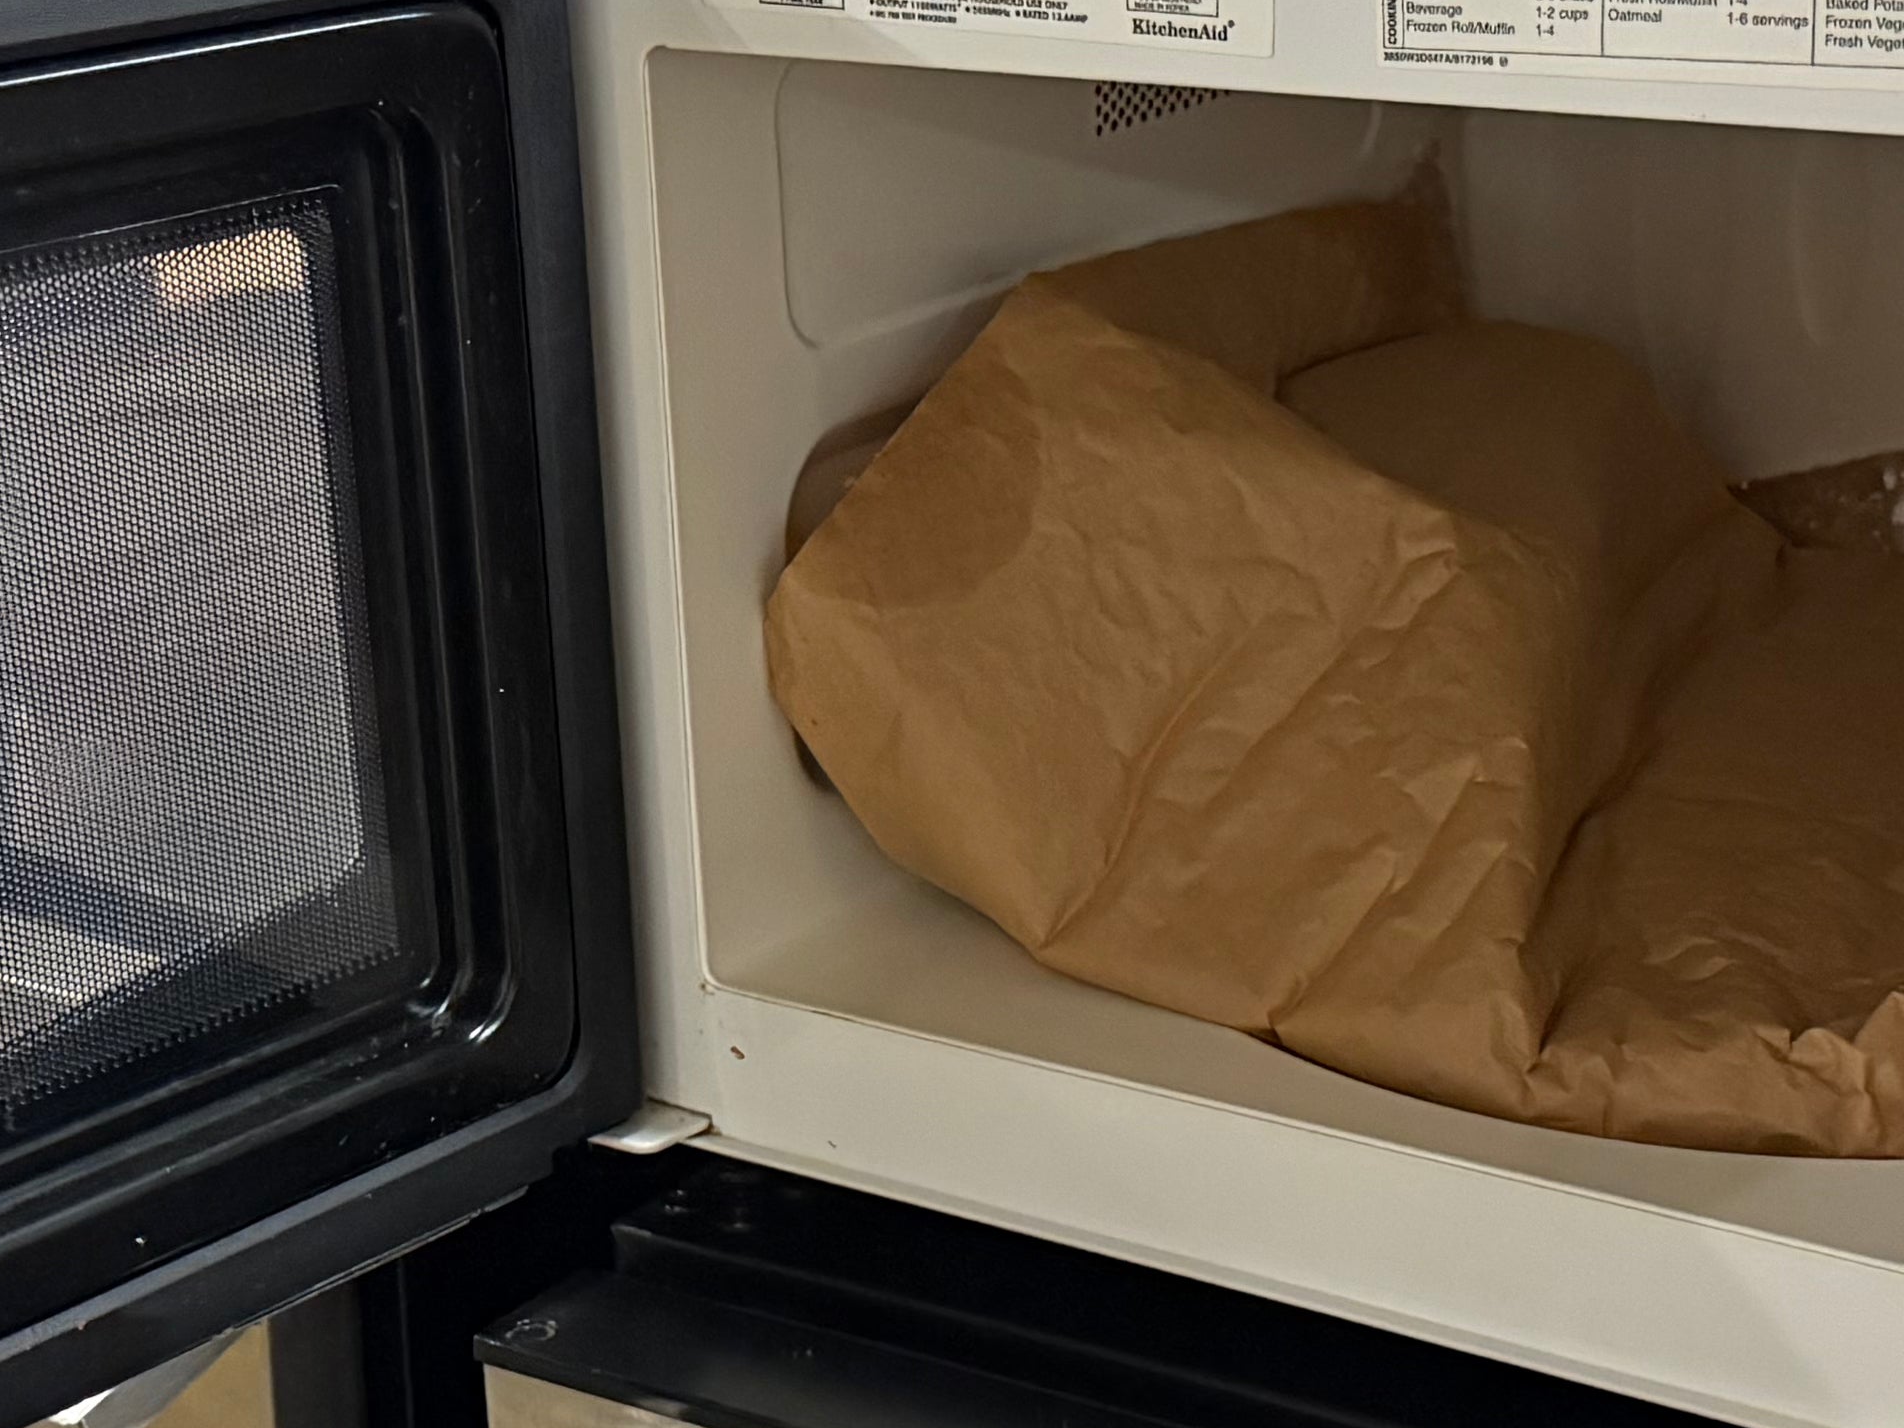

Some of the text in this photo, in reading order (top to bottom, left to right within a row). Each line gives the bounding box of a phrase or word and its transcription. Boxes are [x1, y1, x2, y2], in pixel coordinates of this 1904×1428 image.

[1406, 1, 1589, 22] Beverage 1-2 cups
[1608, 8, 1809, 30] Oatmeal 1-6 servings
[1406, 20, 1555, 37] Frozen Roll/Muffin 1-4
[1825, 15, 1872, 31] Frozen
[1825, 34, 1864, 49] Fresh
